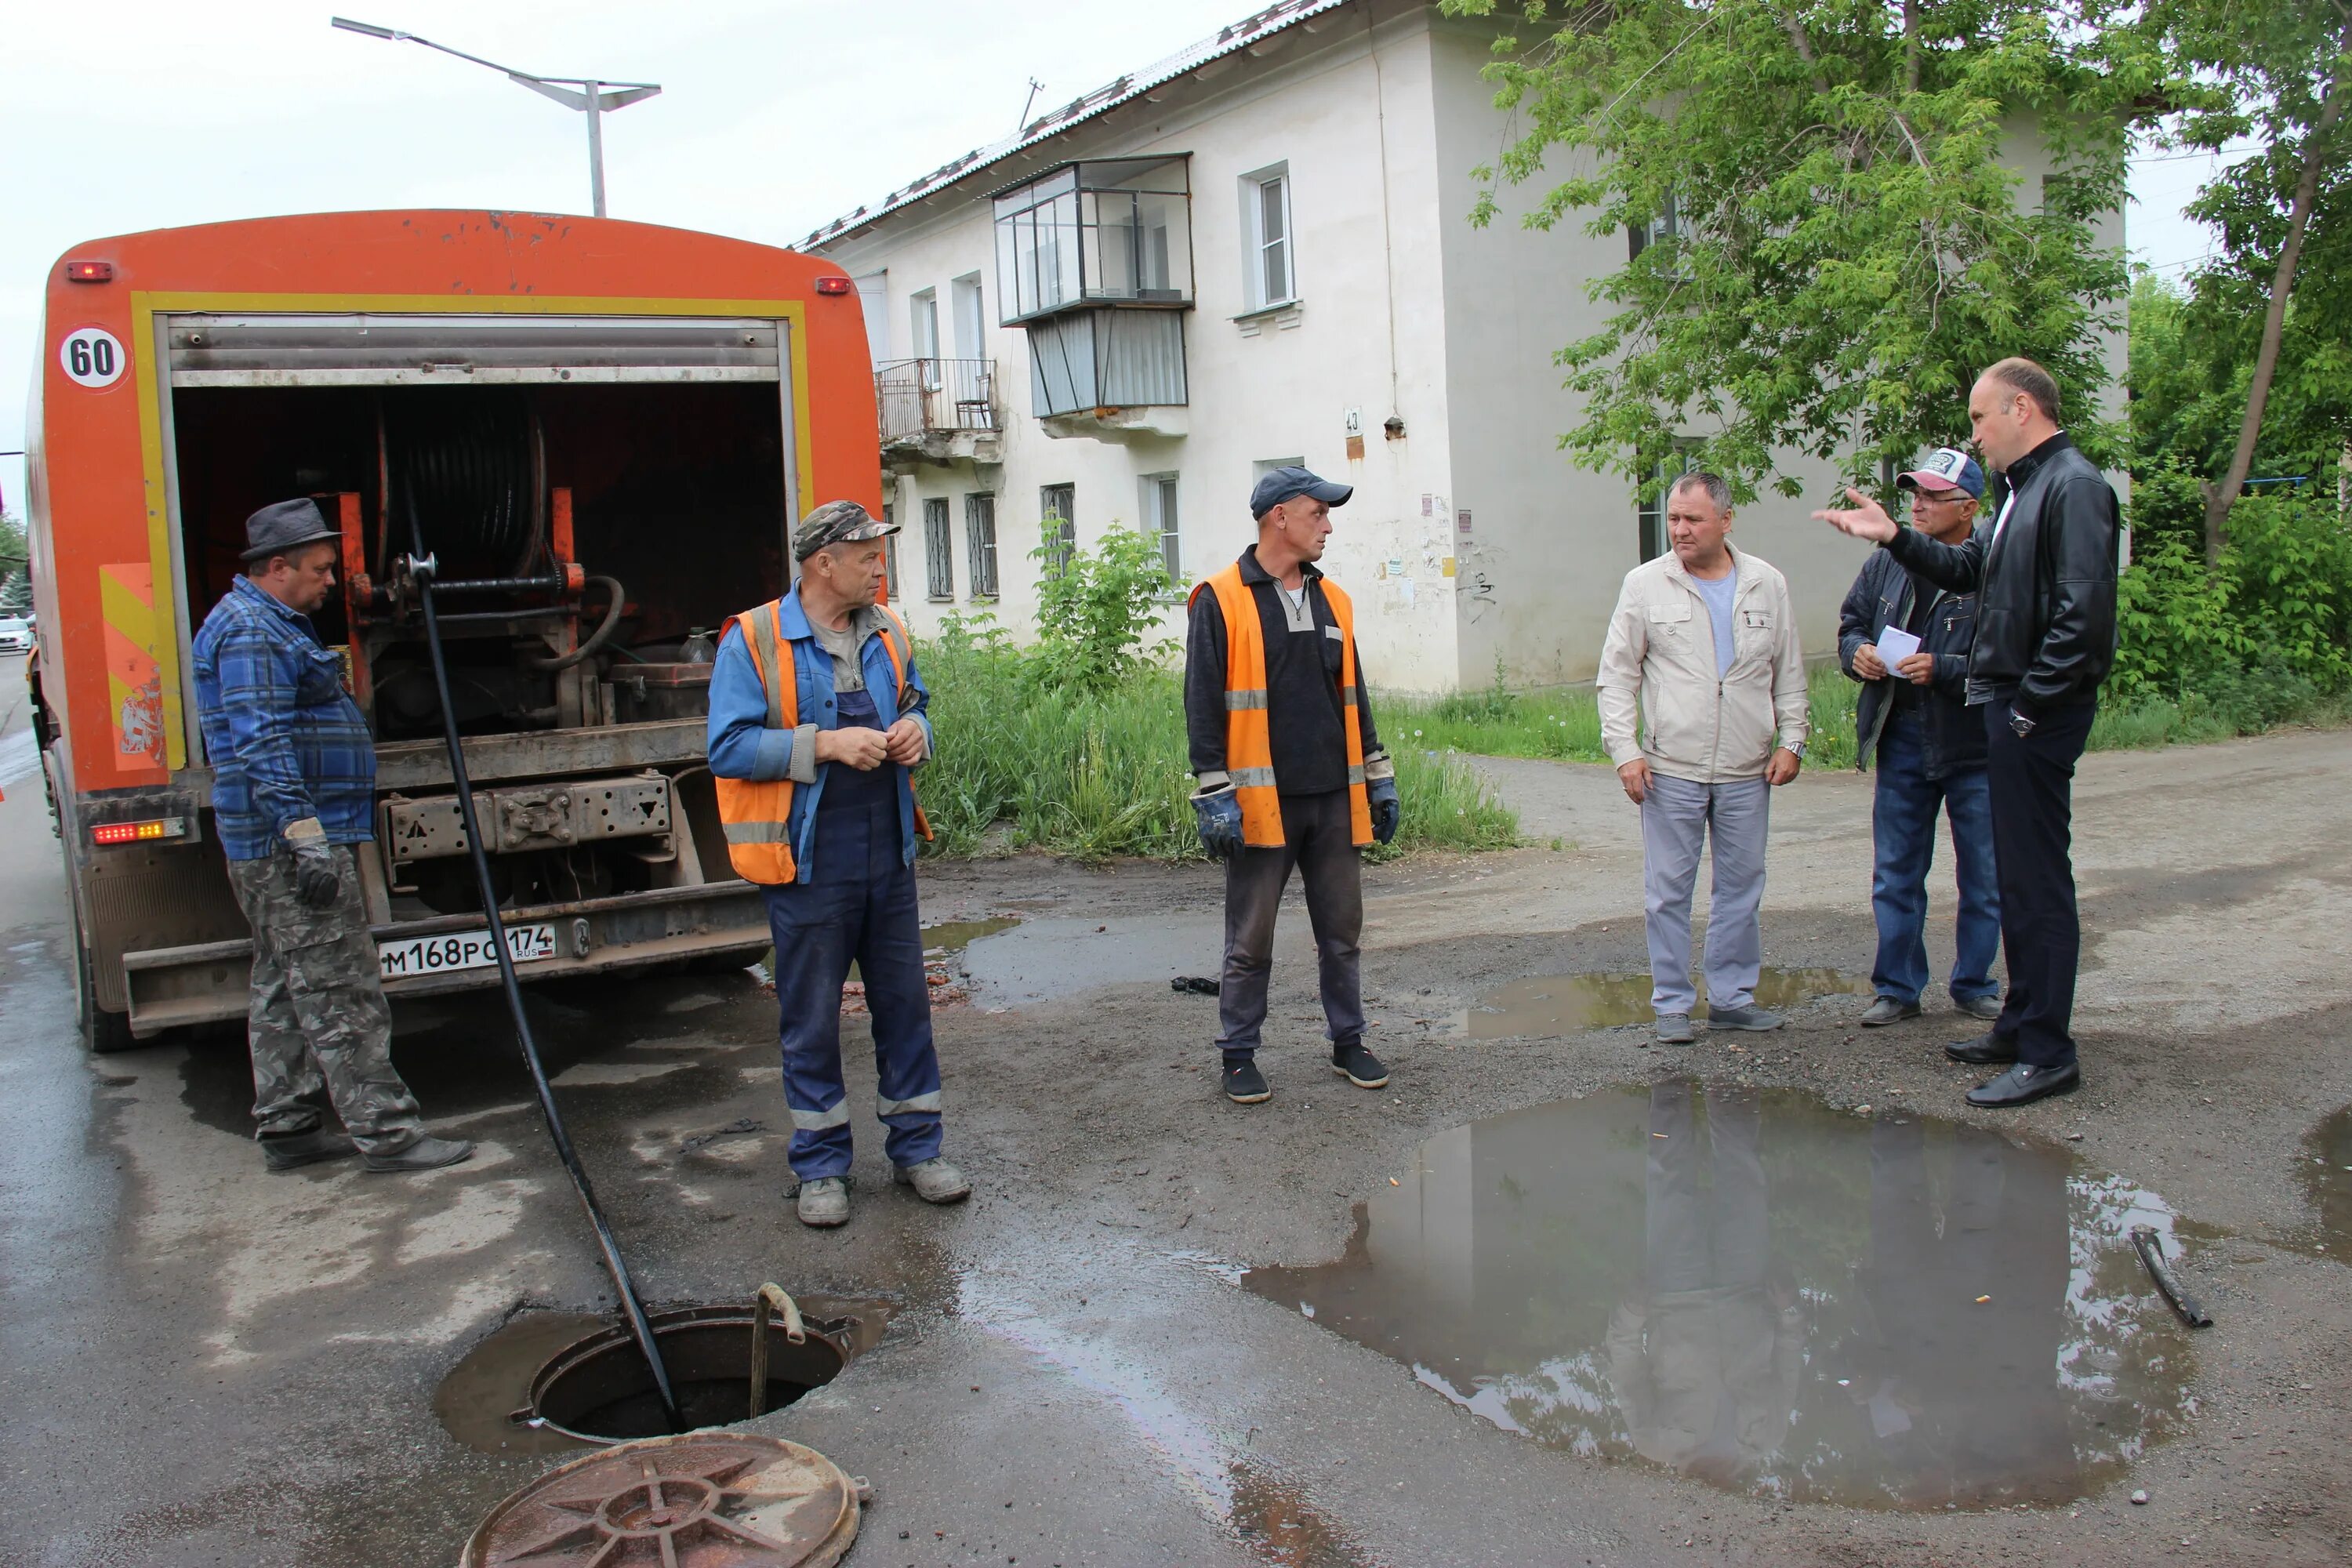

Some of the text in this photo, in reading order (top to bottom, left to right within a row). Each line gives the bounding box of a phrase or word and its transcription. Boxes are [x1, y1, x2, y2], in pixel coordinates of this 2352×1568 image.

[71, 339, 114, 376] 60
[509, 927, 548, 951] 174
[517, 949, 538, 958] RUS
